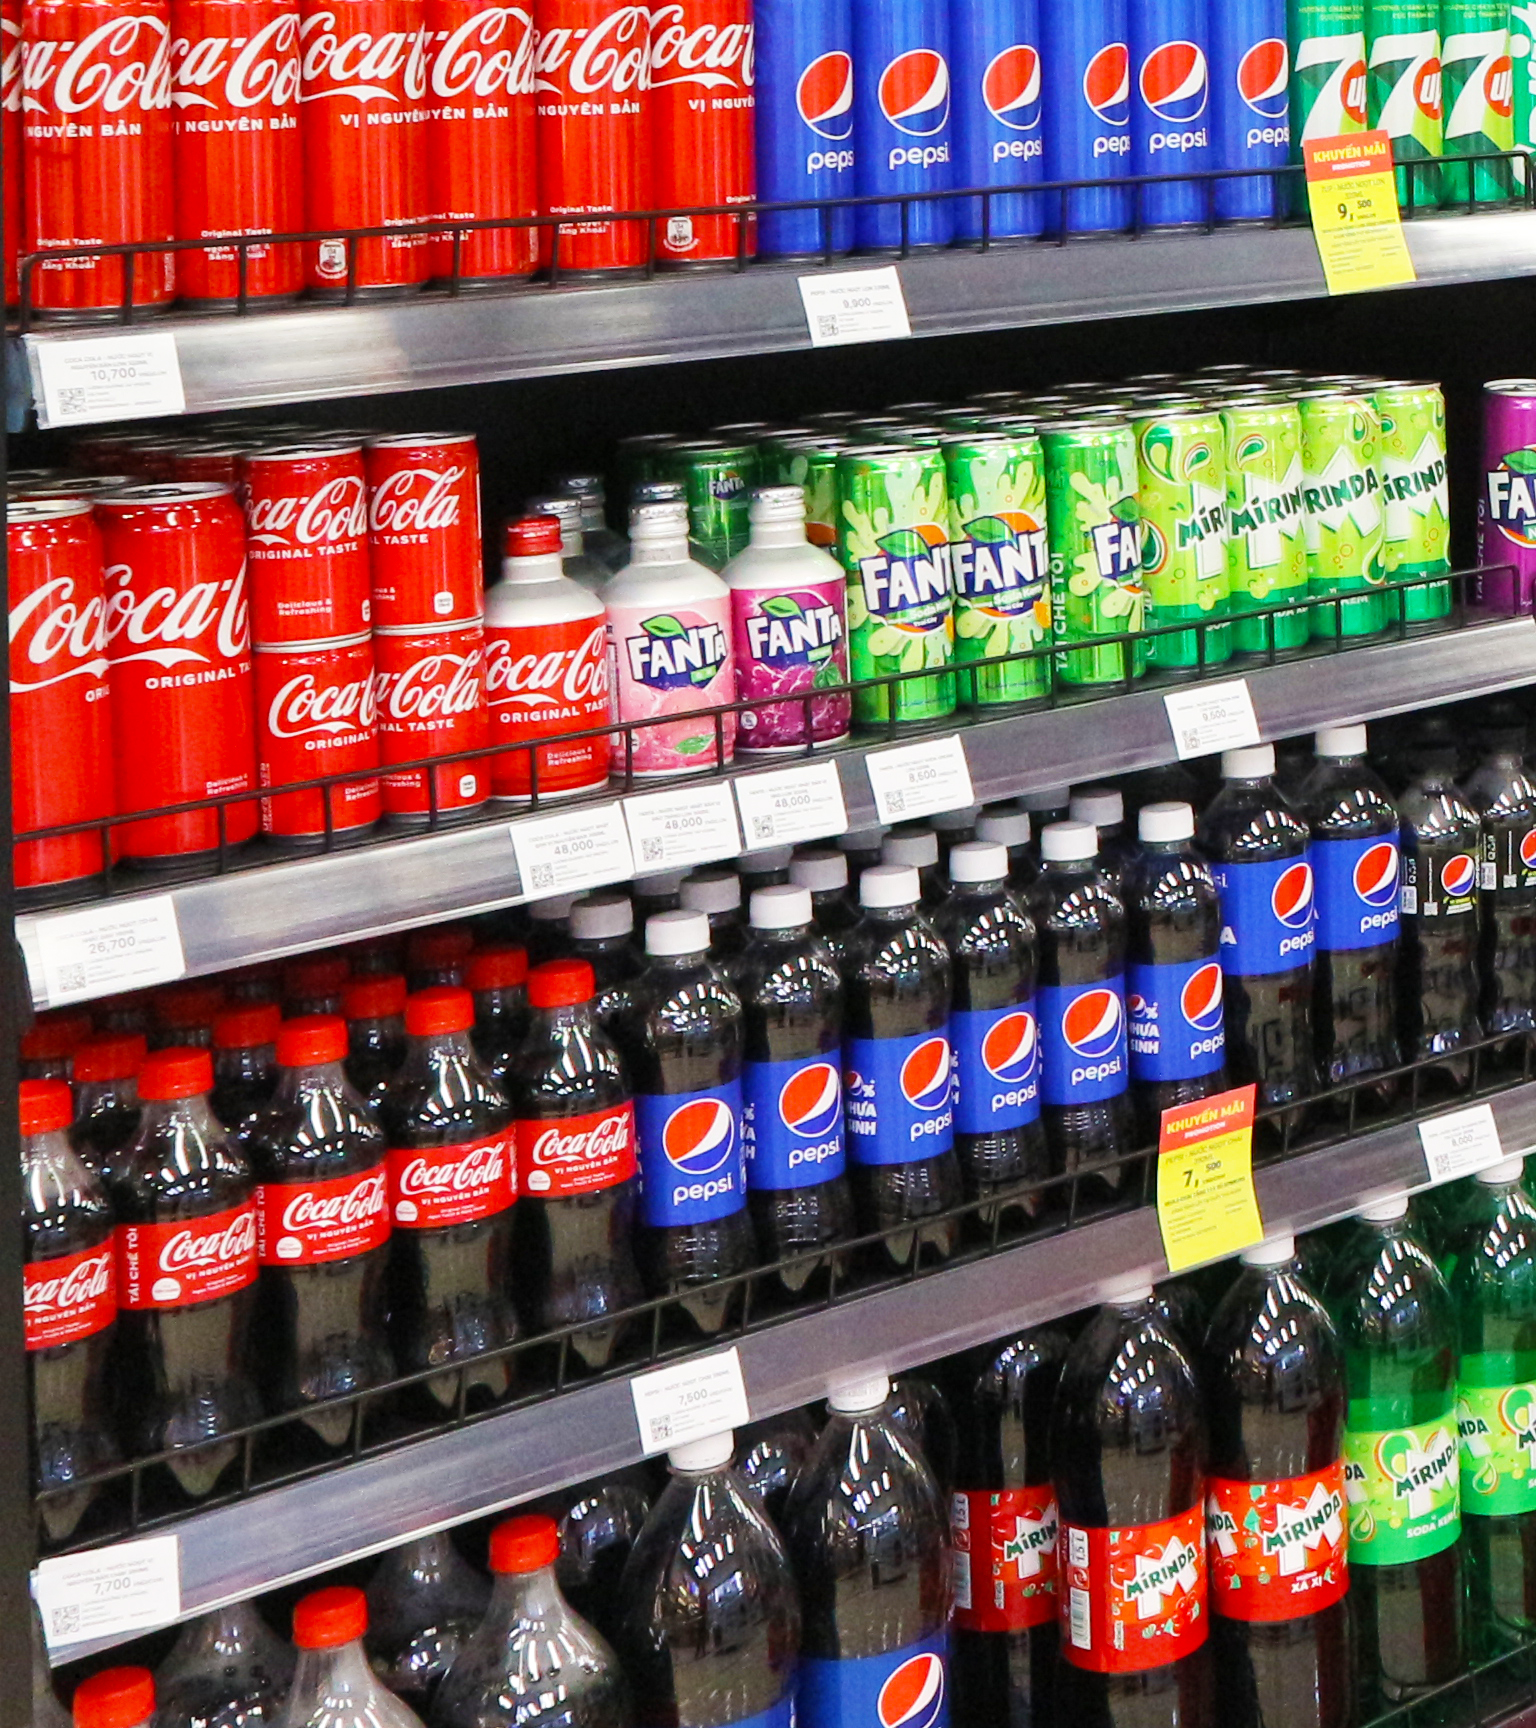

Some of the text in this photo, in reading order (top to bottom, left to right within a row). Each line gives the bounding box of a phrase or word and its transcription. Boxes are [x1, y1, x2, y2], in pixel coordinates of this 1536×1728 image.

[611, 100, 640, 115] BẢN
[185, 113, 297, 134] NGUYÊN BẢN
[1149, 126, 1207, 154] pepsi
[888, 140, 951, 171] pepsi
[89, 364, 137, 381] 10,700
[317, 541, 358, 557] TASTE
[746, 603, 843, 660] FANTA
[627, 617, 727, 684] FANTA
[144, 668, 237, 691] ORIGINAL
[407, 719, 455, 732] TASTE
[500, 706, 587, 725] ORIGINAL
[773, 793, 811, 810] 48,000
[552, 837, 594, 856] 48,000
[1360, 904, 1399, 934] pepsi
[1070, 1055, 1121, 1086] pepsi
[531, 1111, 631, 1166] Coca-Cola
[788, 1134, 841, 1170] pepsi
[399, 1142, 504, 1196] Coca-Cola
[672, 1168, 734, 1206] pepsi
[282, 1172, 385, 1231] Coca-Cola
[86, 1317, 137, 1338] 26,700
[677, 1387, 709, 1407] 7,500
[92, 1576, 132, 1595] 7,700
